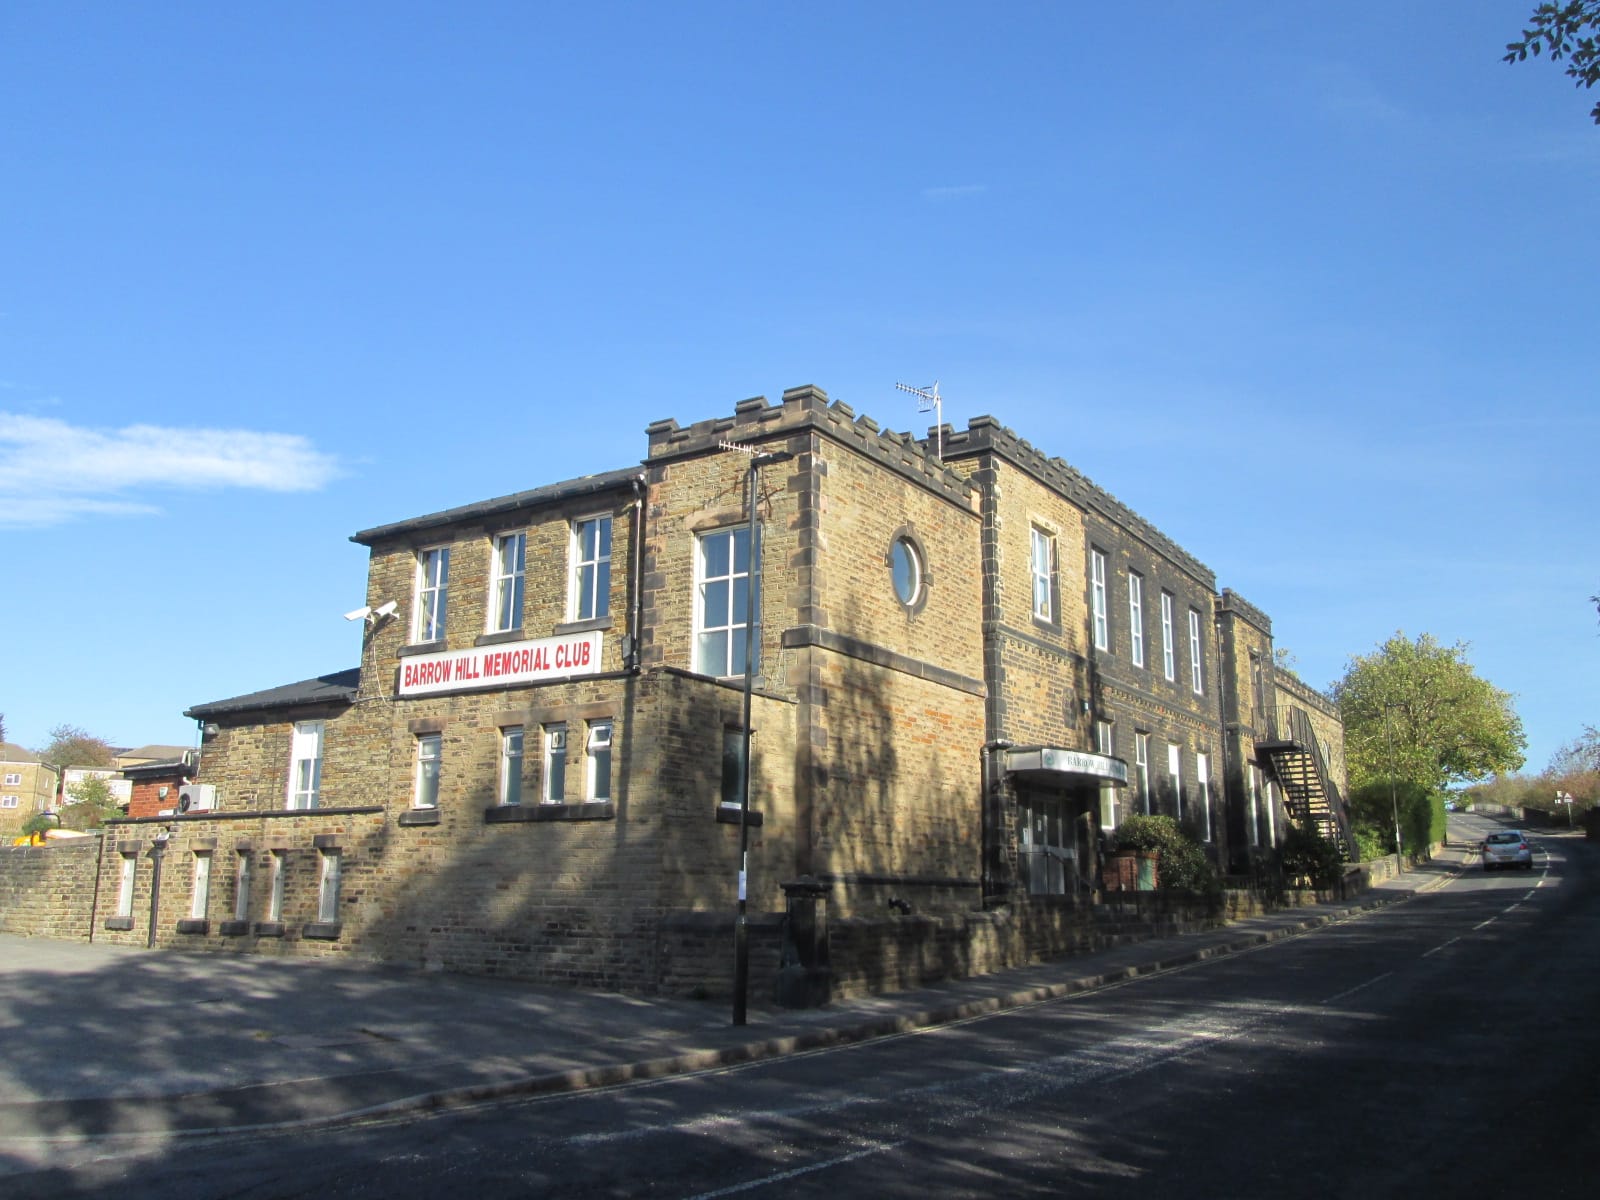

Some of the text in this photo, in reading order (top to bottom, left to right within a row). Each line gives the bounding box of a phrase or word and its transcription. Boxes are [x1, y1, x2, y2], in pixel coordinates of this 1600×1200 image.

[405, 641, 590, 686] BARROW HILL MEMORIAL CLUB
